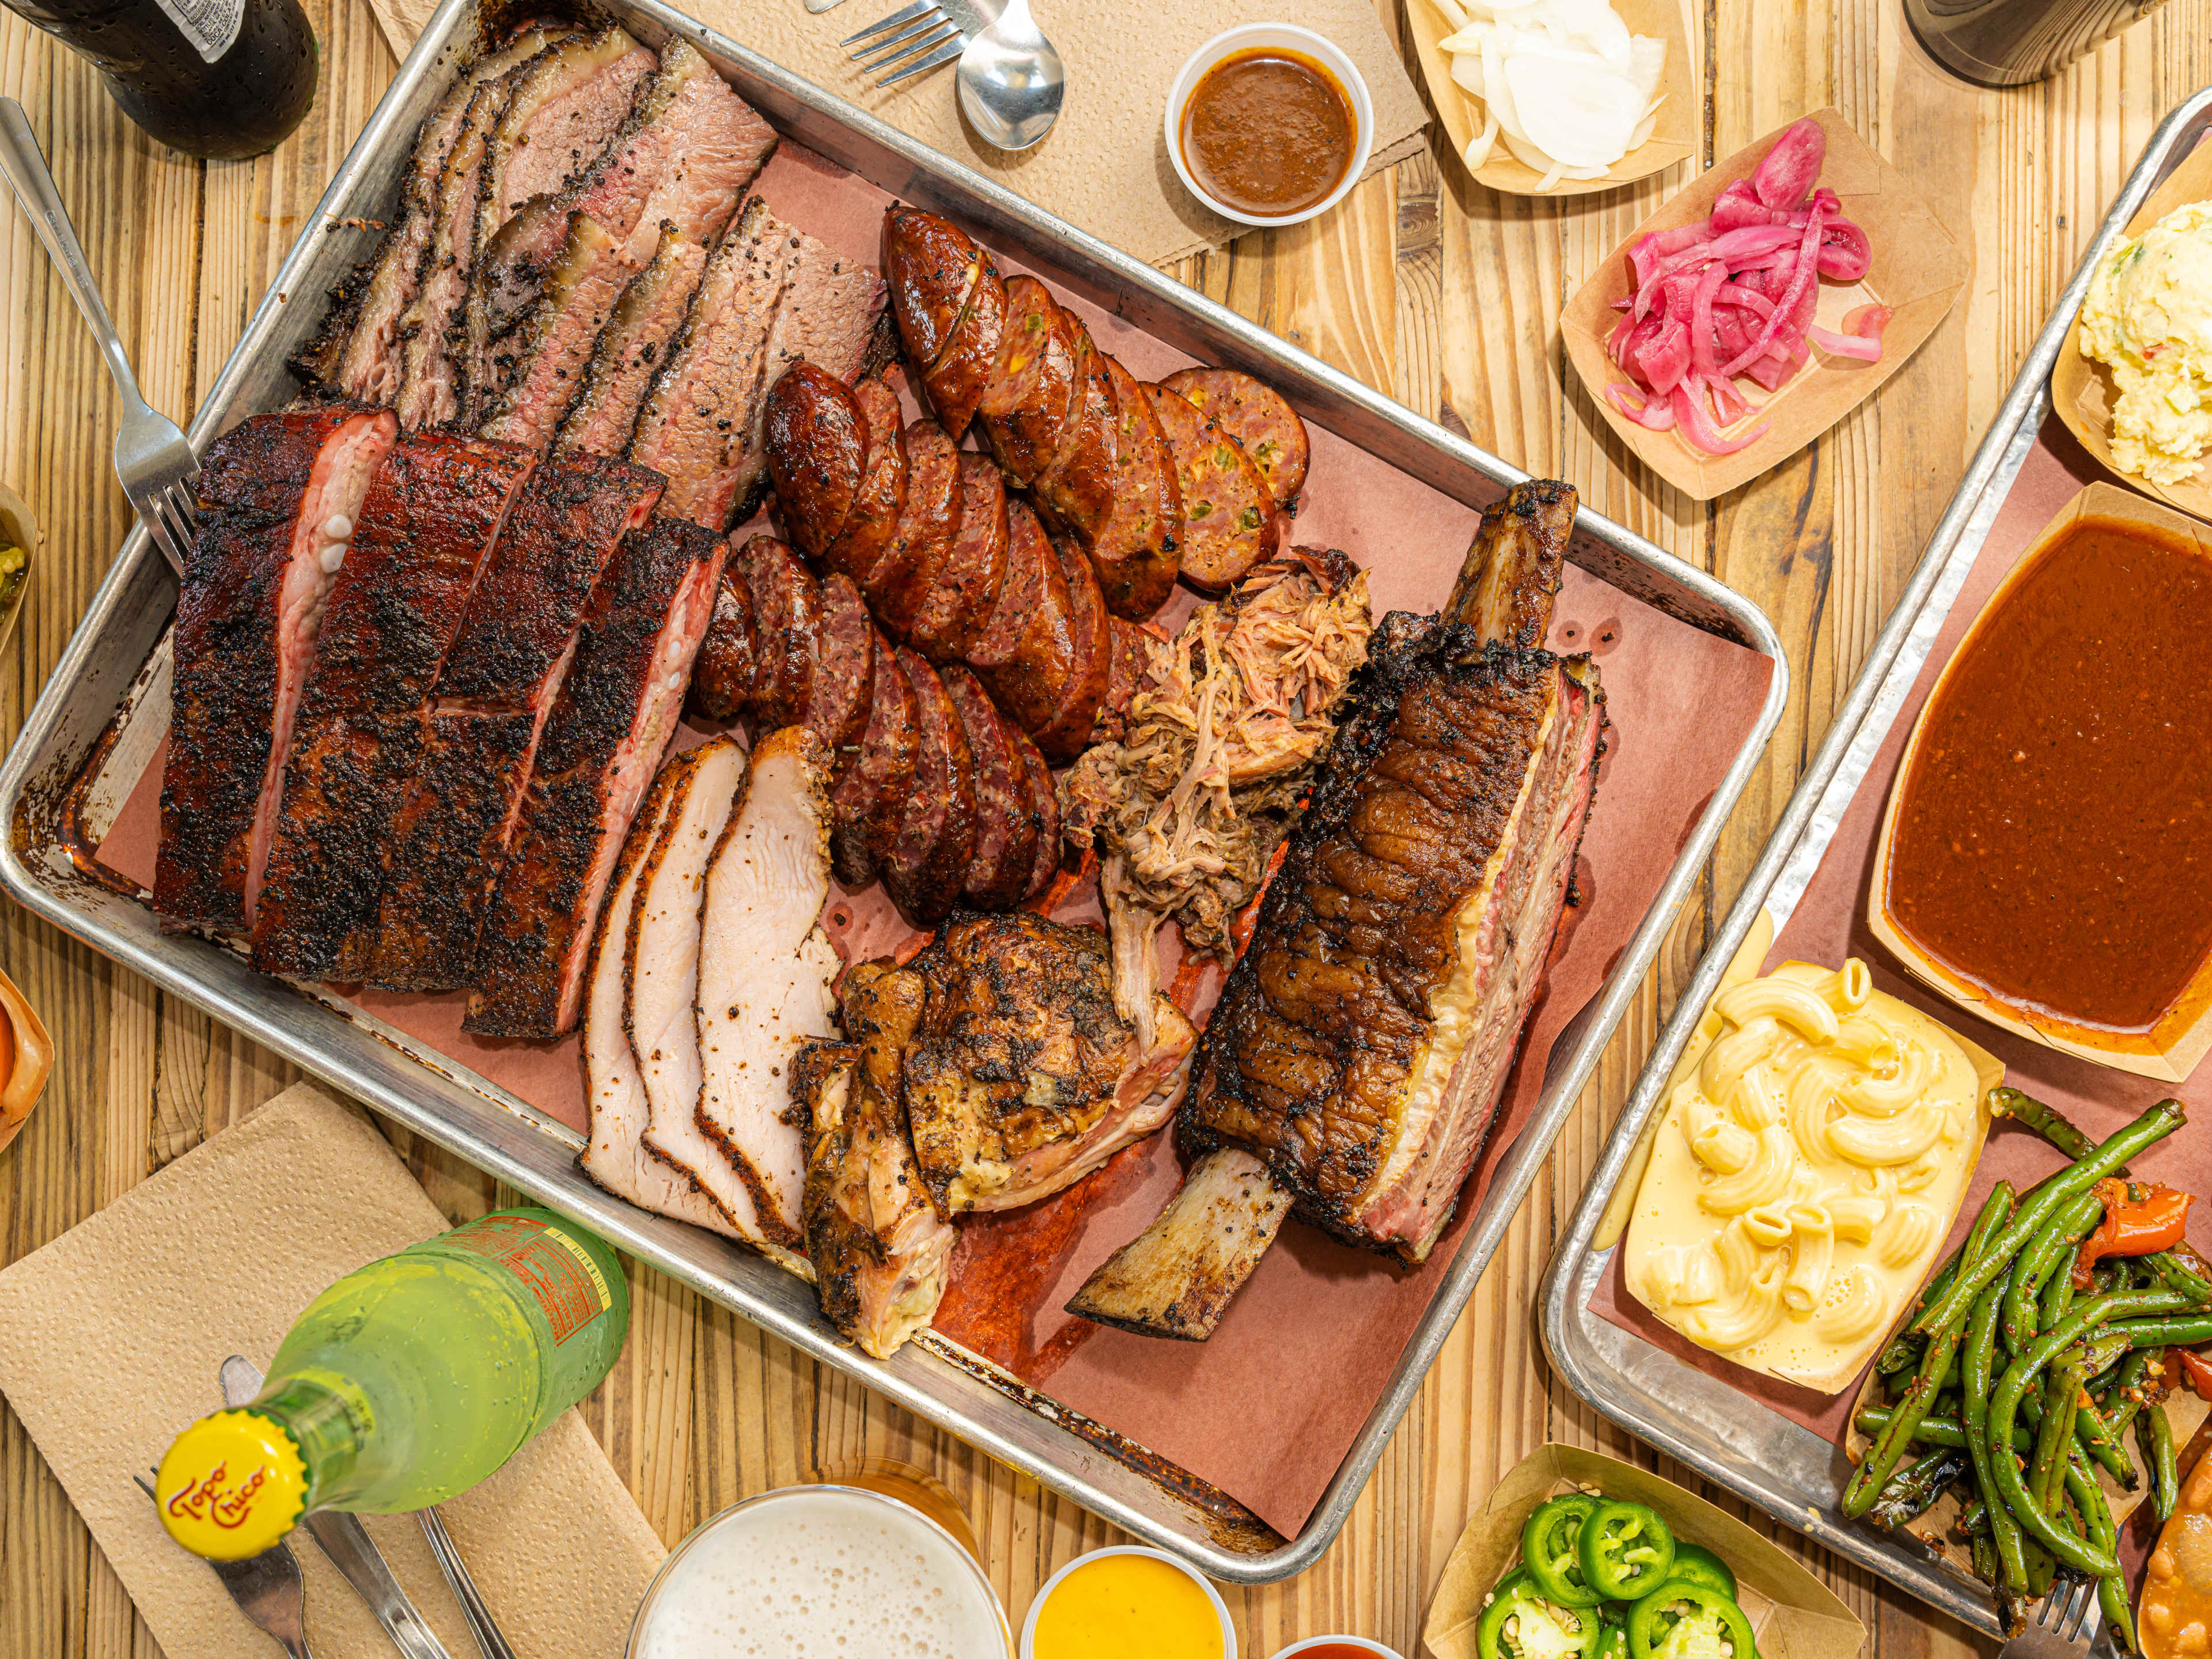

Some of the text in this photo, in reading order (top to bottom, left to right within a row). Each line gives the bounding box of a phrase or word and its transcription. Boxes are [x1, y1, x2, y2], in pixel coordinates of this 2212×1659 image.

[206, 7, 231, 46] COCA-COLA
[166, 1460, 226, 1521] Topo
[210, 1464, 264, 1529] Chico
